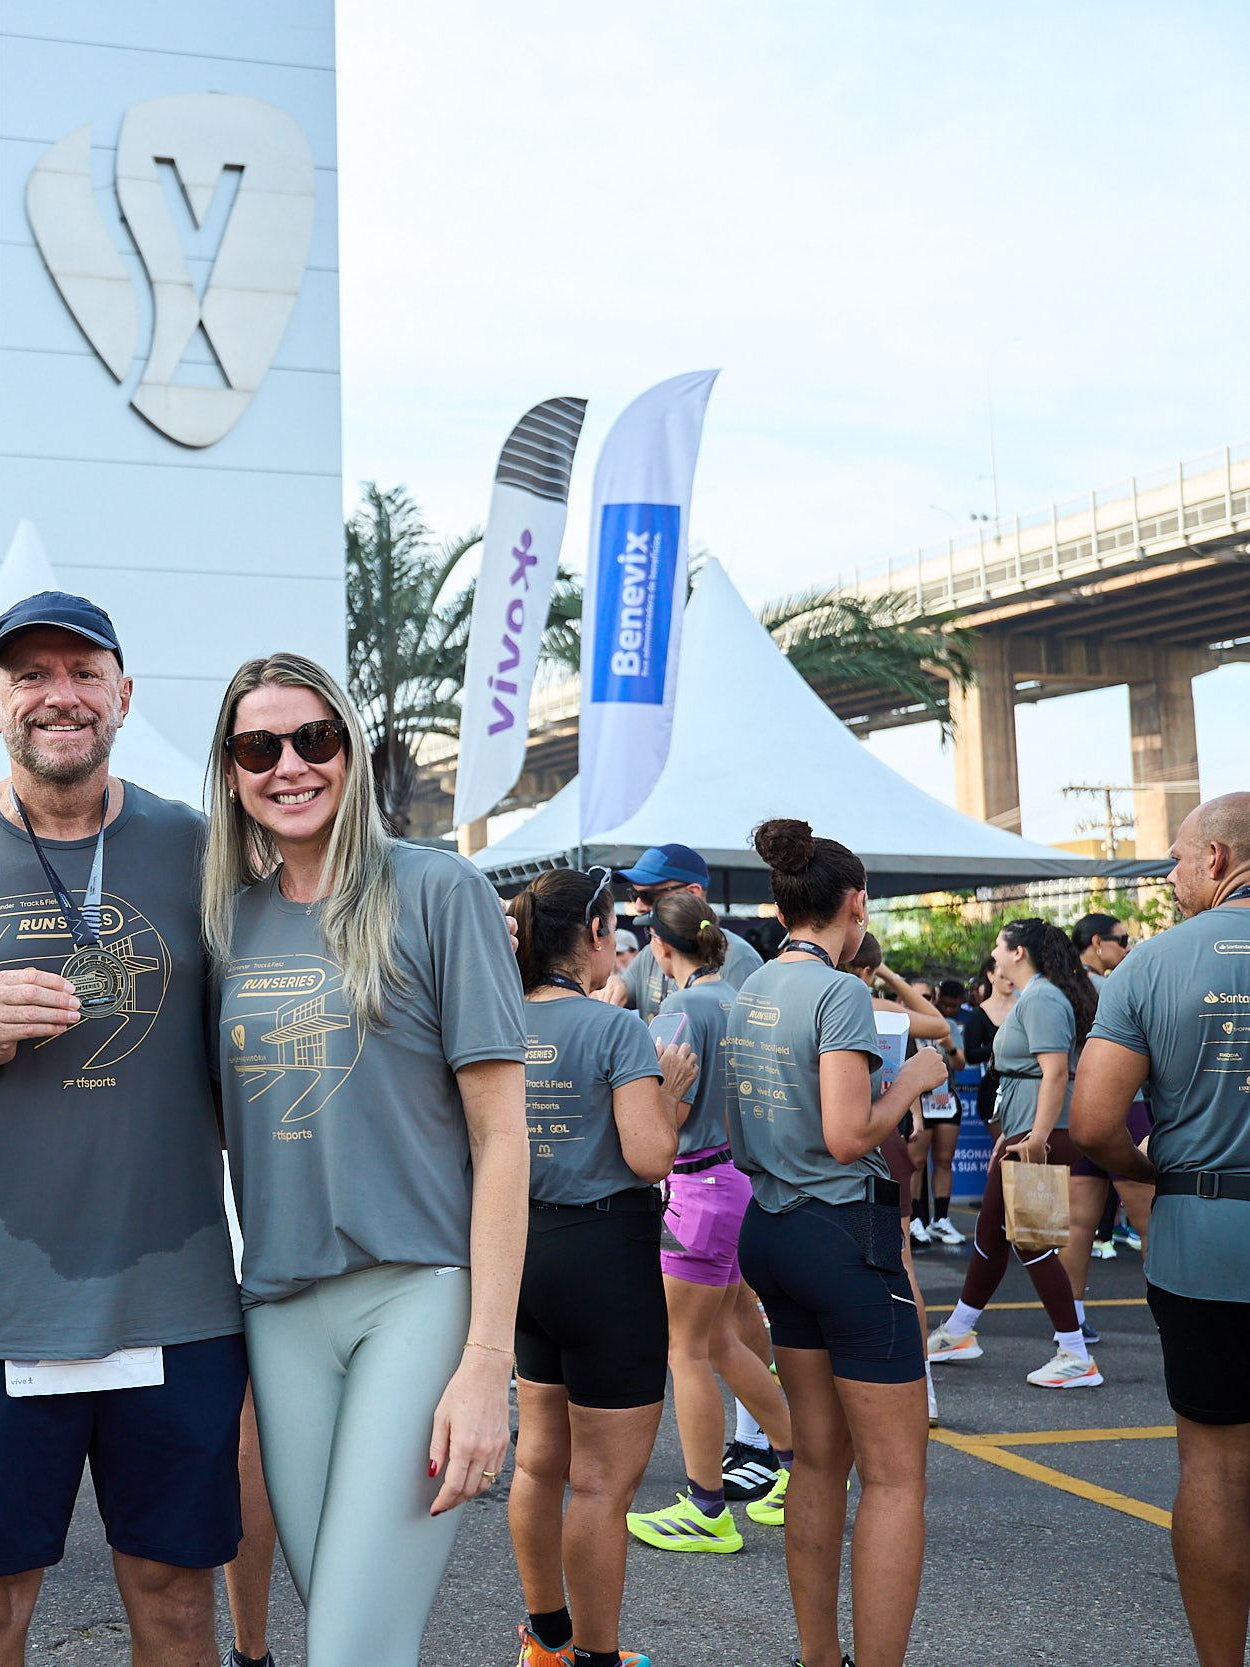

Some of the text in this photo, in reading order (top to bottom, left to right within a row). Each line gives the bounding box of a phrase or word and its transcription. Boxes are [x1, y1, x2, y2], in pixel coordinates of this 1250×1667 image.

[610, 530, 650, 677] Benevix
[487, 597, 525, 737] vivo
[76, 1077, 117, 1090] tfsports
[550, 1124, 569, 1133] GOL
[277, 1129, 312, 1142] tfsports
[958, 1161, 977, 1171] SUA
[11, 1377, 27, 1385] vivo
